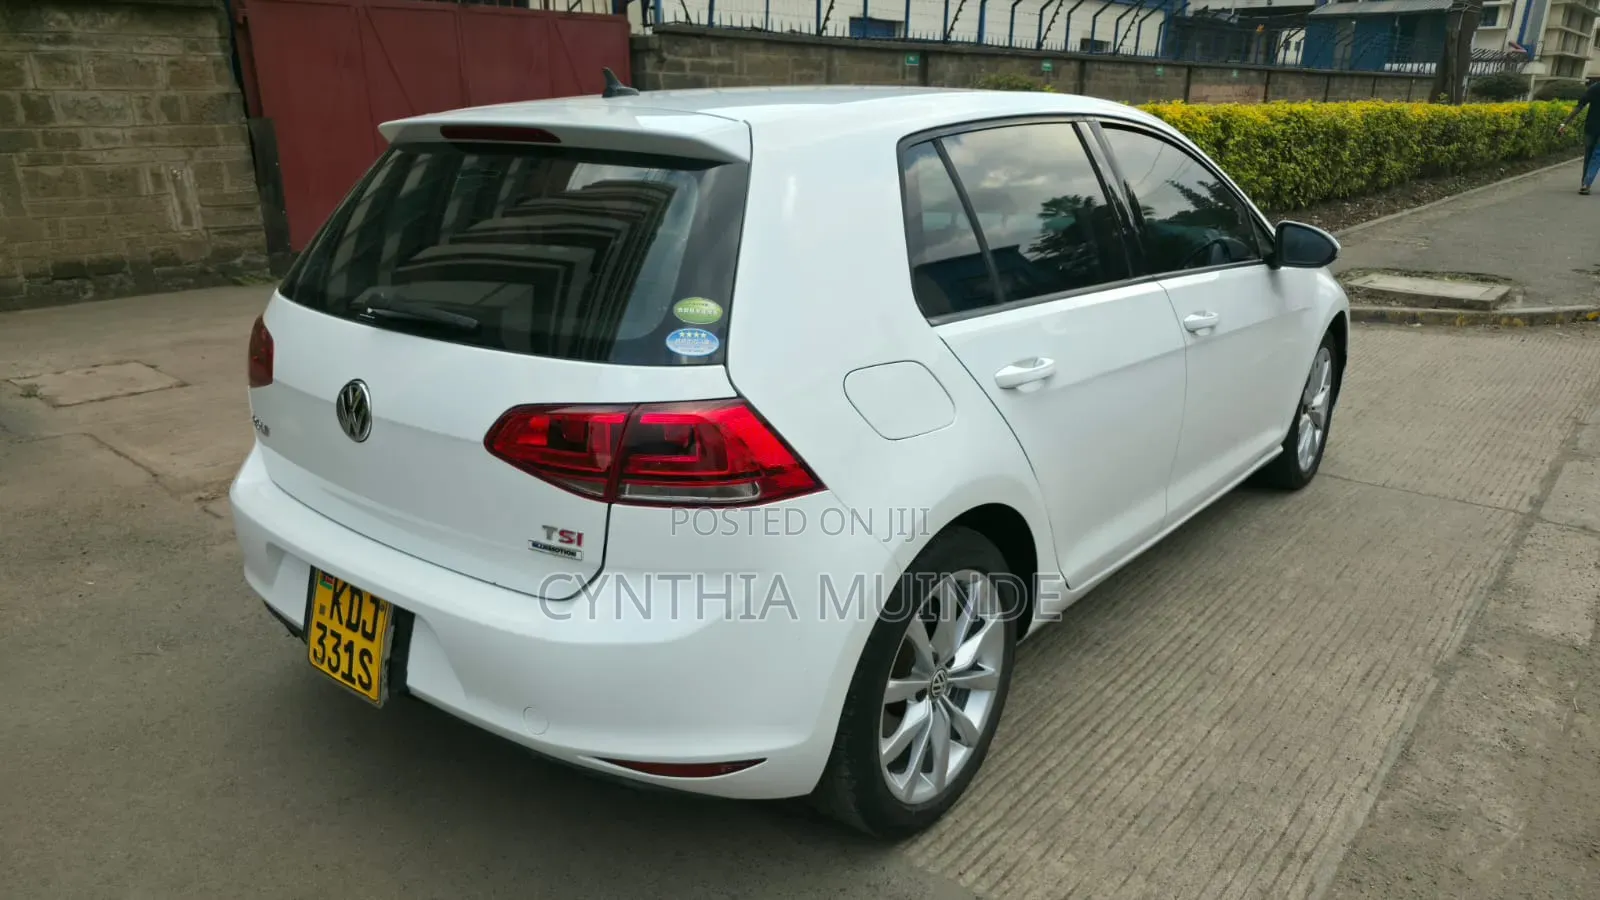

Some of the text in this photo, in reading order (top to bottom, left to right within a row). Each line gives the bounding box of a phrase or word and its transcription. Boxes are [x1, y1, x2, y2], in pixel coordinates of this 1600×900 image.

[542, 525, 584, 547] TSI
[330, 576, 382, 643] KDJ
[313, 621, 373, 691] 331S
